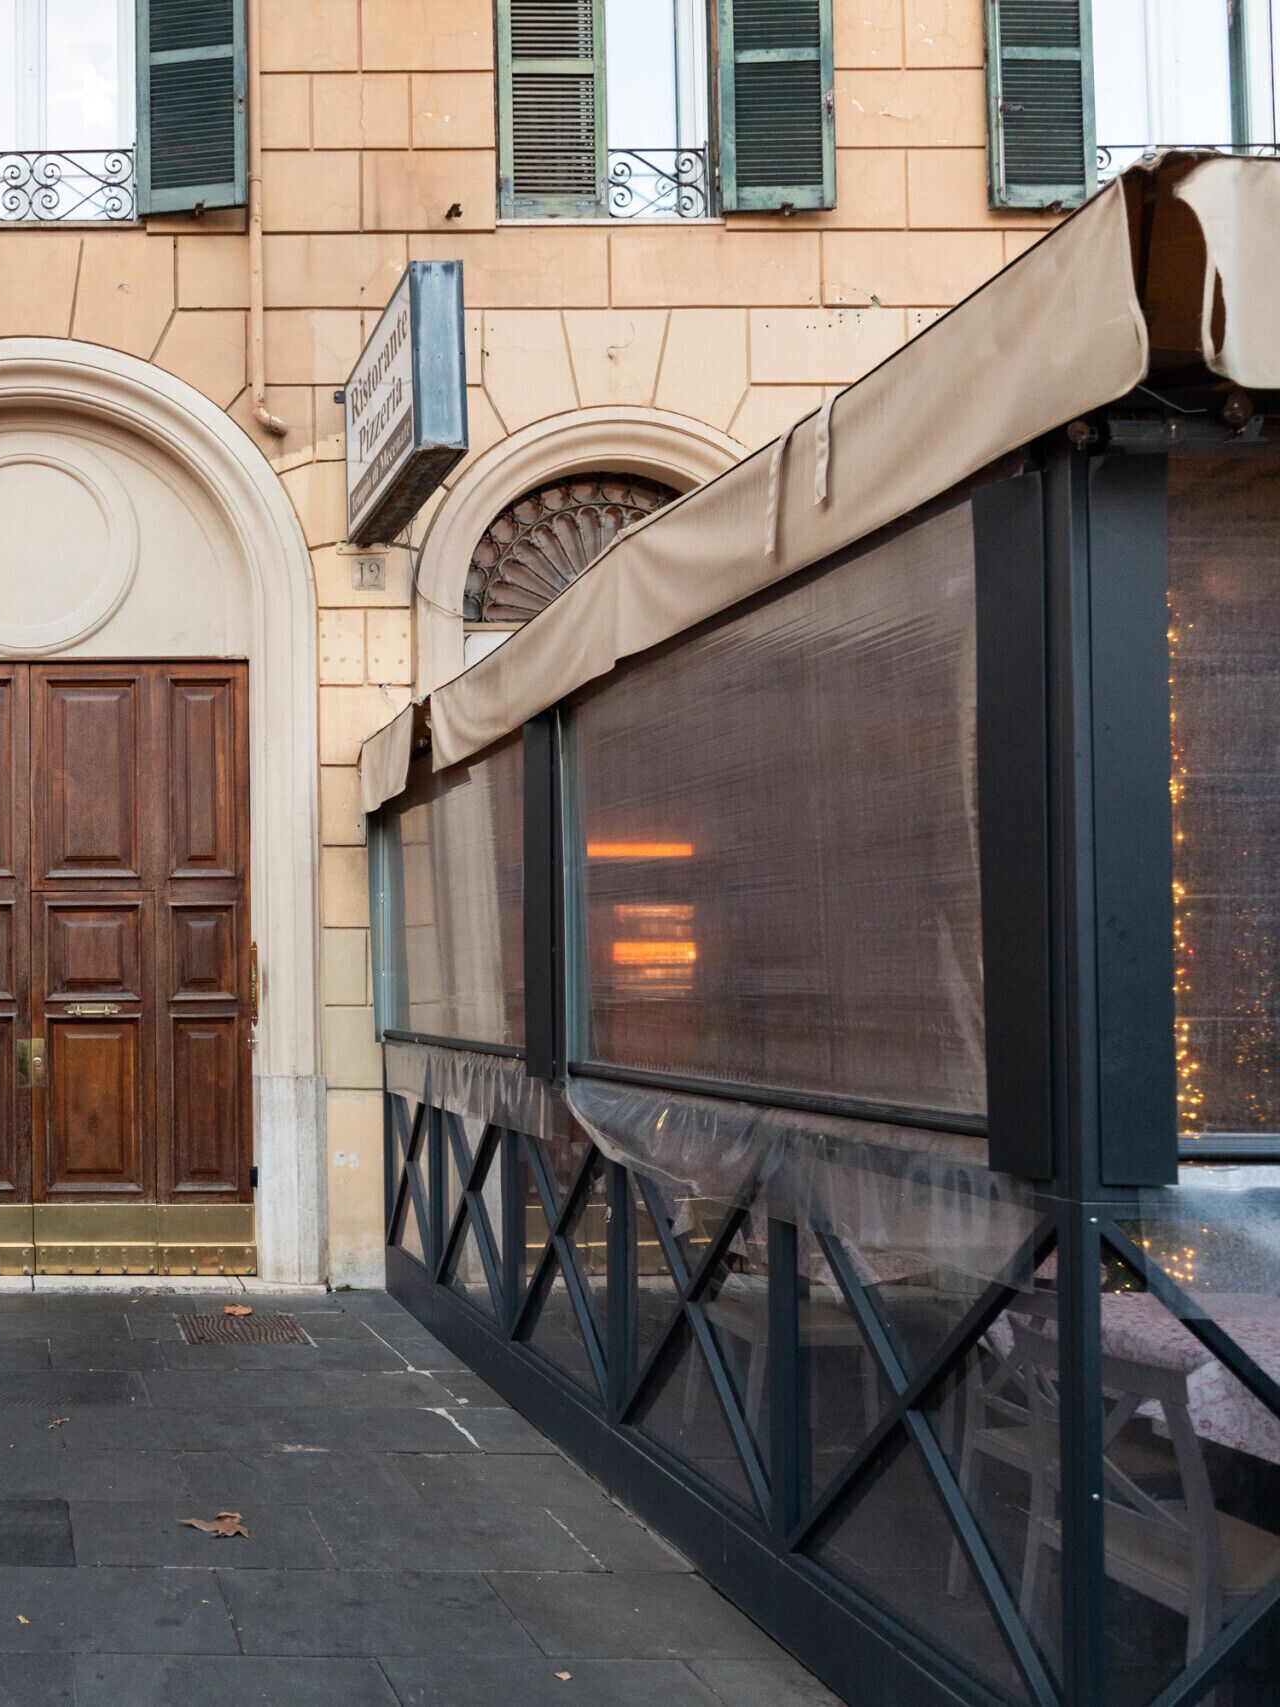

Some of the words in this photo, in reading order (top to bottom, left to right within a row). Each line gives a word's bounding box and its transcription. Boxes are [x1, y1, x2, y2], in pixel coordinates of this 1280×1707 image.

[351, 309, 408, 425] Ristorante
[358, 375, 403, 463] Pizzeria
[371, 461, 379, 486] di
